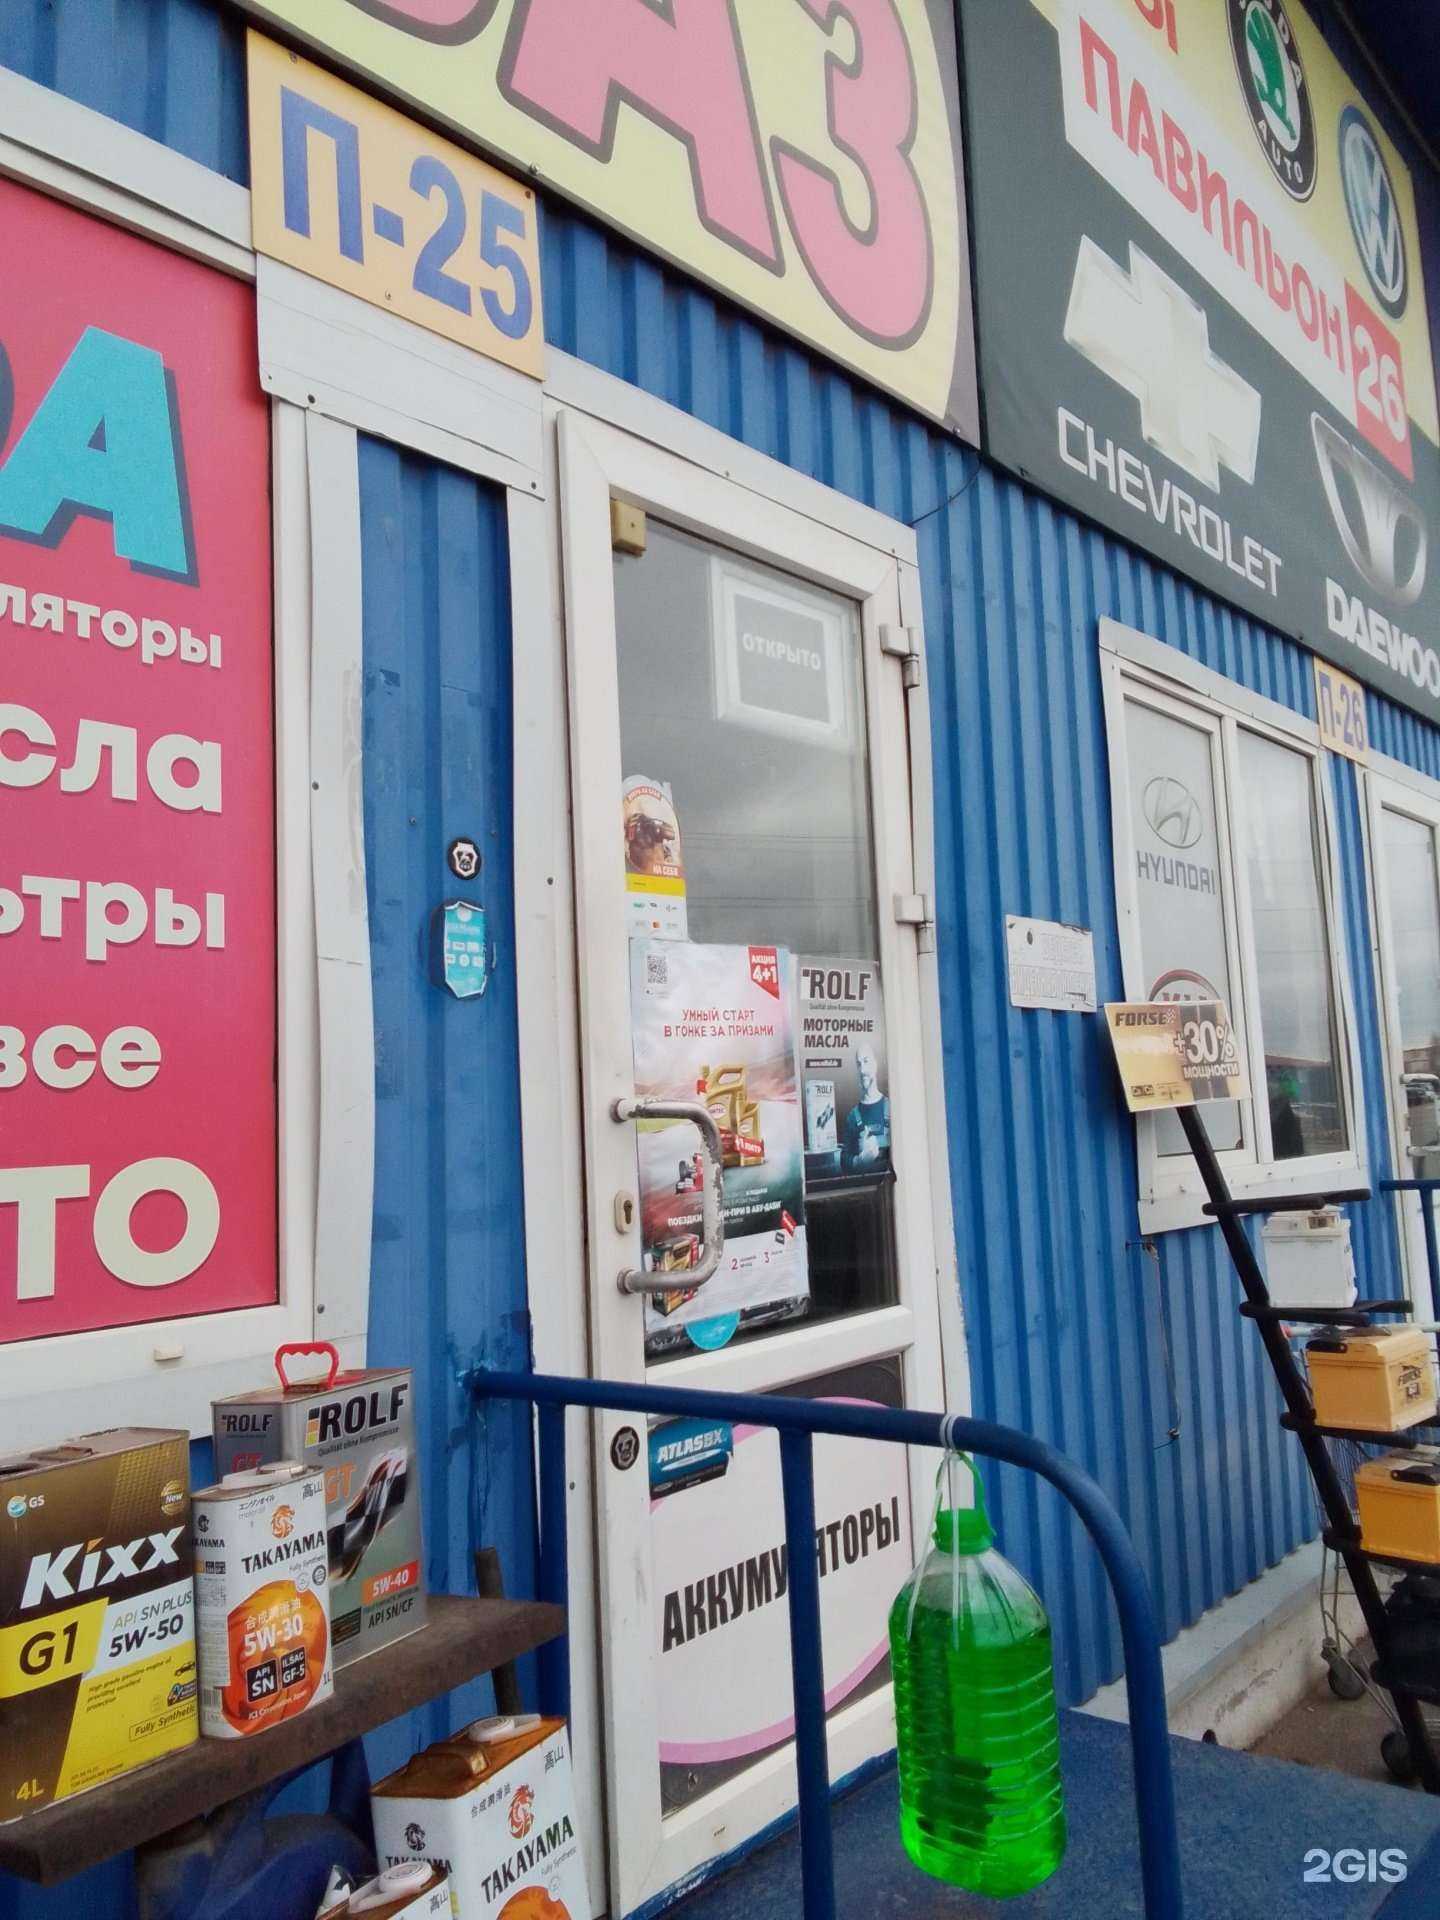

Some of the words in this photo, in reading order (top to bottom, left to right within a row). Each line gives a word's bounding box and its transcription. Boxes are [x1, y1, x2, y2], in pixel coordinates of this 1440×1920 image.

[1258, 119, 1303, 183] AUTO
[340, 0, 935, 350] АЗ
[281, 86, 533, 340] П-25
[1079, 15, 1346, 374] ПАВИЛЬОН
[1353, 326, 1407, 444] 26
[0, 325, 199, 588] А
[1058, 406, 1282, 597] CHEVROLET
[742, 632, 821, 671] ОТКРЫТО
[1326, 576, 1440, 698] DAEWOO
[1319, 671, 1364, 750] П-26
[1136, 849, 1216, 895] HYUNDAI
[751, 955, 776, 964] АКЦИЯ
[753, 965, 777, 983] 4+1
[809, 970, 871, 1000] ROLF
[664, 1026, 672, 1037] В
[676, 1026, 706, 1037] ГОНКЕ
[711, 1026, 725, 1037] ЗА
[729, 1025, 774, 1037] ПРИЗАМИ
[683, 1007, 719, 1022] УМНЫЙ
[723, 1010, 755, 1021] СТАРТ
[803, 1018, 873, 1032] МОТОРНЫЕ
[1115, 1012, 1166, 1026] FORSE
[804, 1034, 849, 1048] МАСЛА
[1173, 1020, 1237, 1063] +30%
[1183, 1064, 1239, 1080] МОЩНОСТИ
[223, 1414, 272, 1432] ROLF
[318, 1383, 408, 1441] ROLF
[656, 1428, 723, 1463] ATLASBX
[29, 1495, 45, 1508] GS
[165, 1493, 183, 1504] New
[20, 1525, 185, 1610] Kixx
[241, 1530, 326, 1574] TAKAYAMA
[373, 1569, 409, 1597] 5W-40
[662, 1496, 900, 1654] АККУМУЯТОРЫ
[113, 1610, 138, 1632] API
[141, 1600, 161, 1621] SN
[162, 1590, 193, 1616] PLUS
[368, 1612, 385, 1628] API
[386, 1598, 413, 1620] SN/CF
[19, 1621, 78, 1676] G1
[108, 1614, 184, 1658] 5W-50
[244, 1613, 303, 1656] 5W-30
[255, 1666, 270, 1678] API
[282, 1651, 304, 1668] ILSAC
[282, 1664, 305, 1684] GF-5
[251, 1675, 275, 1698] SN
[135, 1718, 155, 1736] Fully
[16, 1779, 45, 1800] 4L
[481, 1814, 575, 1904] TAKAYAMA
